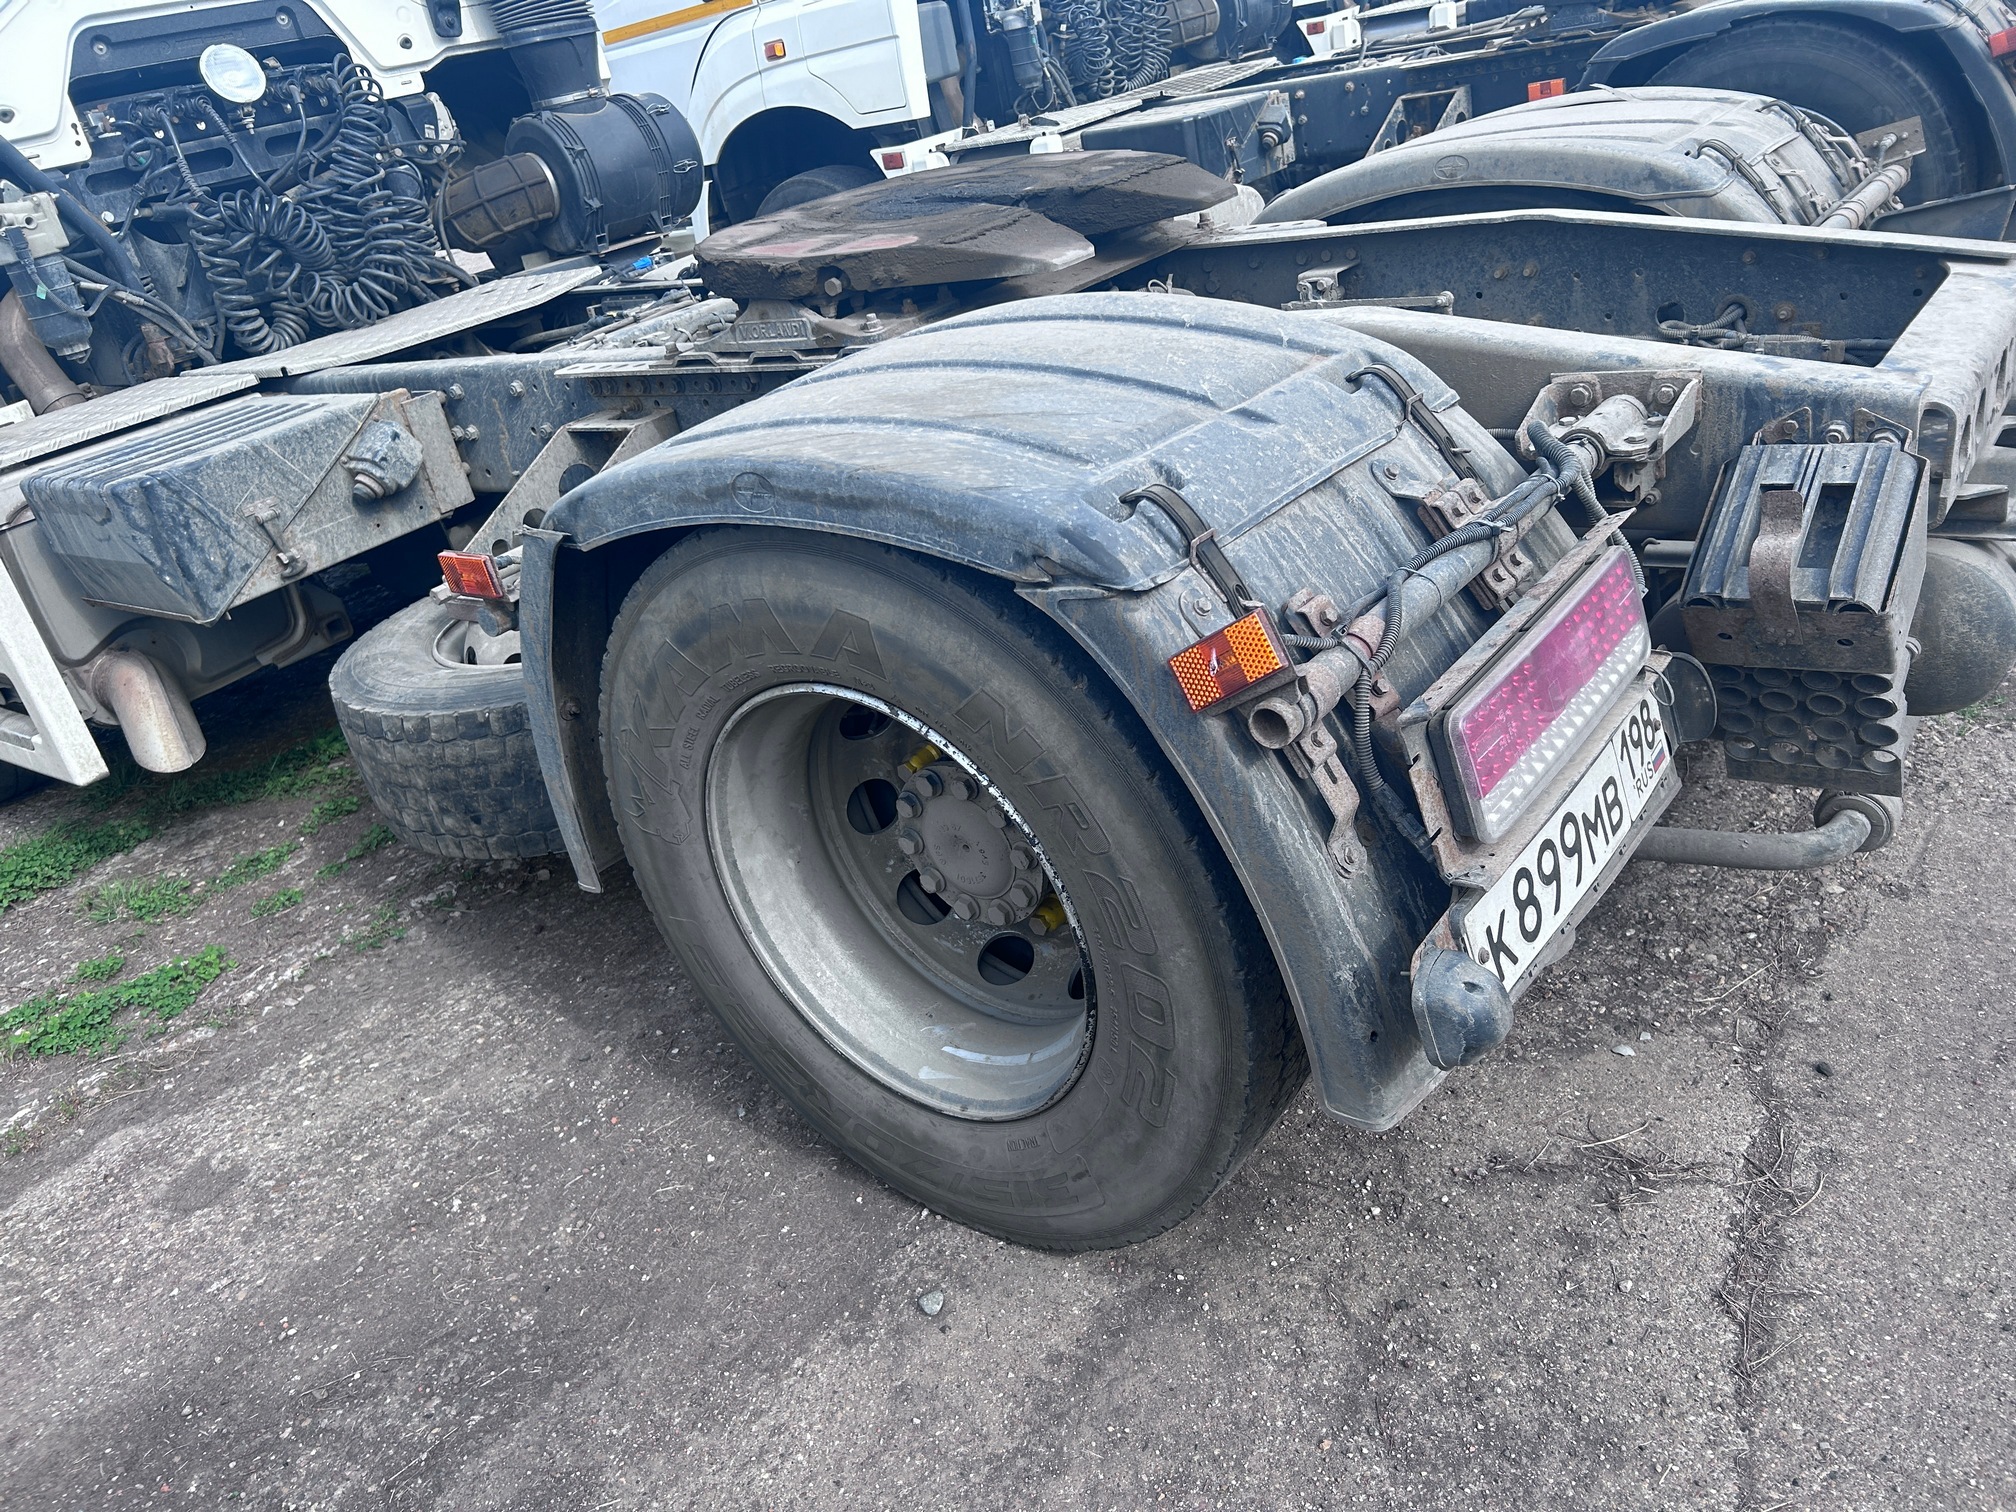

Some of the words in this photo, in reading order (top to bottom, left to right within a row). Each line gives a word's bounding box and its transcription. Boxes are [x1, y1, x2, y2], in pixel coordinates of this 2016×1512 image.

[721, 668, 761, 693] TUBELESS
[767, 663, 841, 679] REGROOVABLE
[626, 597, 887, 792] KAMA
[696, 692, 720, 722] RADIAL
[684, 723, 699, 752] STEEL
[1620, 699, 1659, 779] 198
[681, 750, 691, 771] ALL
[1635, 762, 1654, 799] RUS
[952, 688, 1177, 1128] NR202
